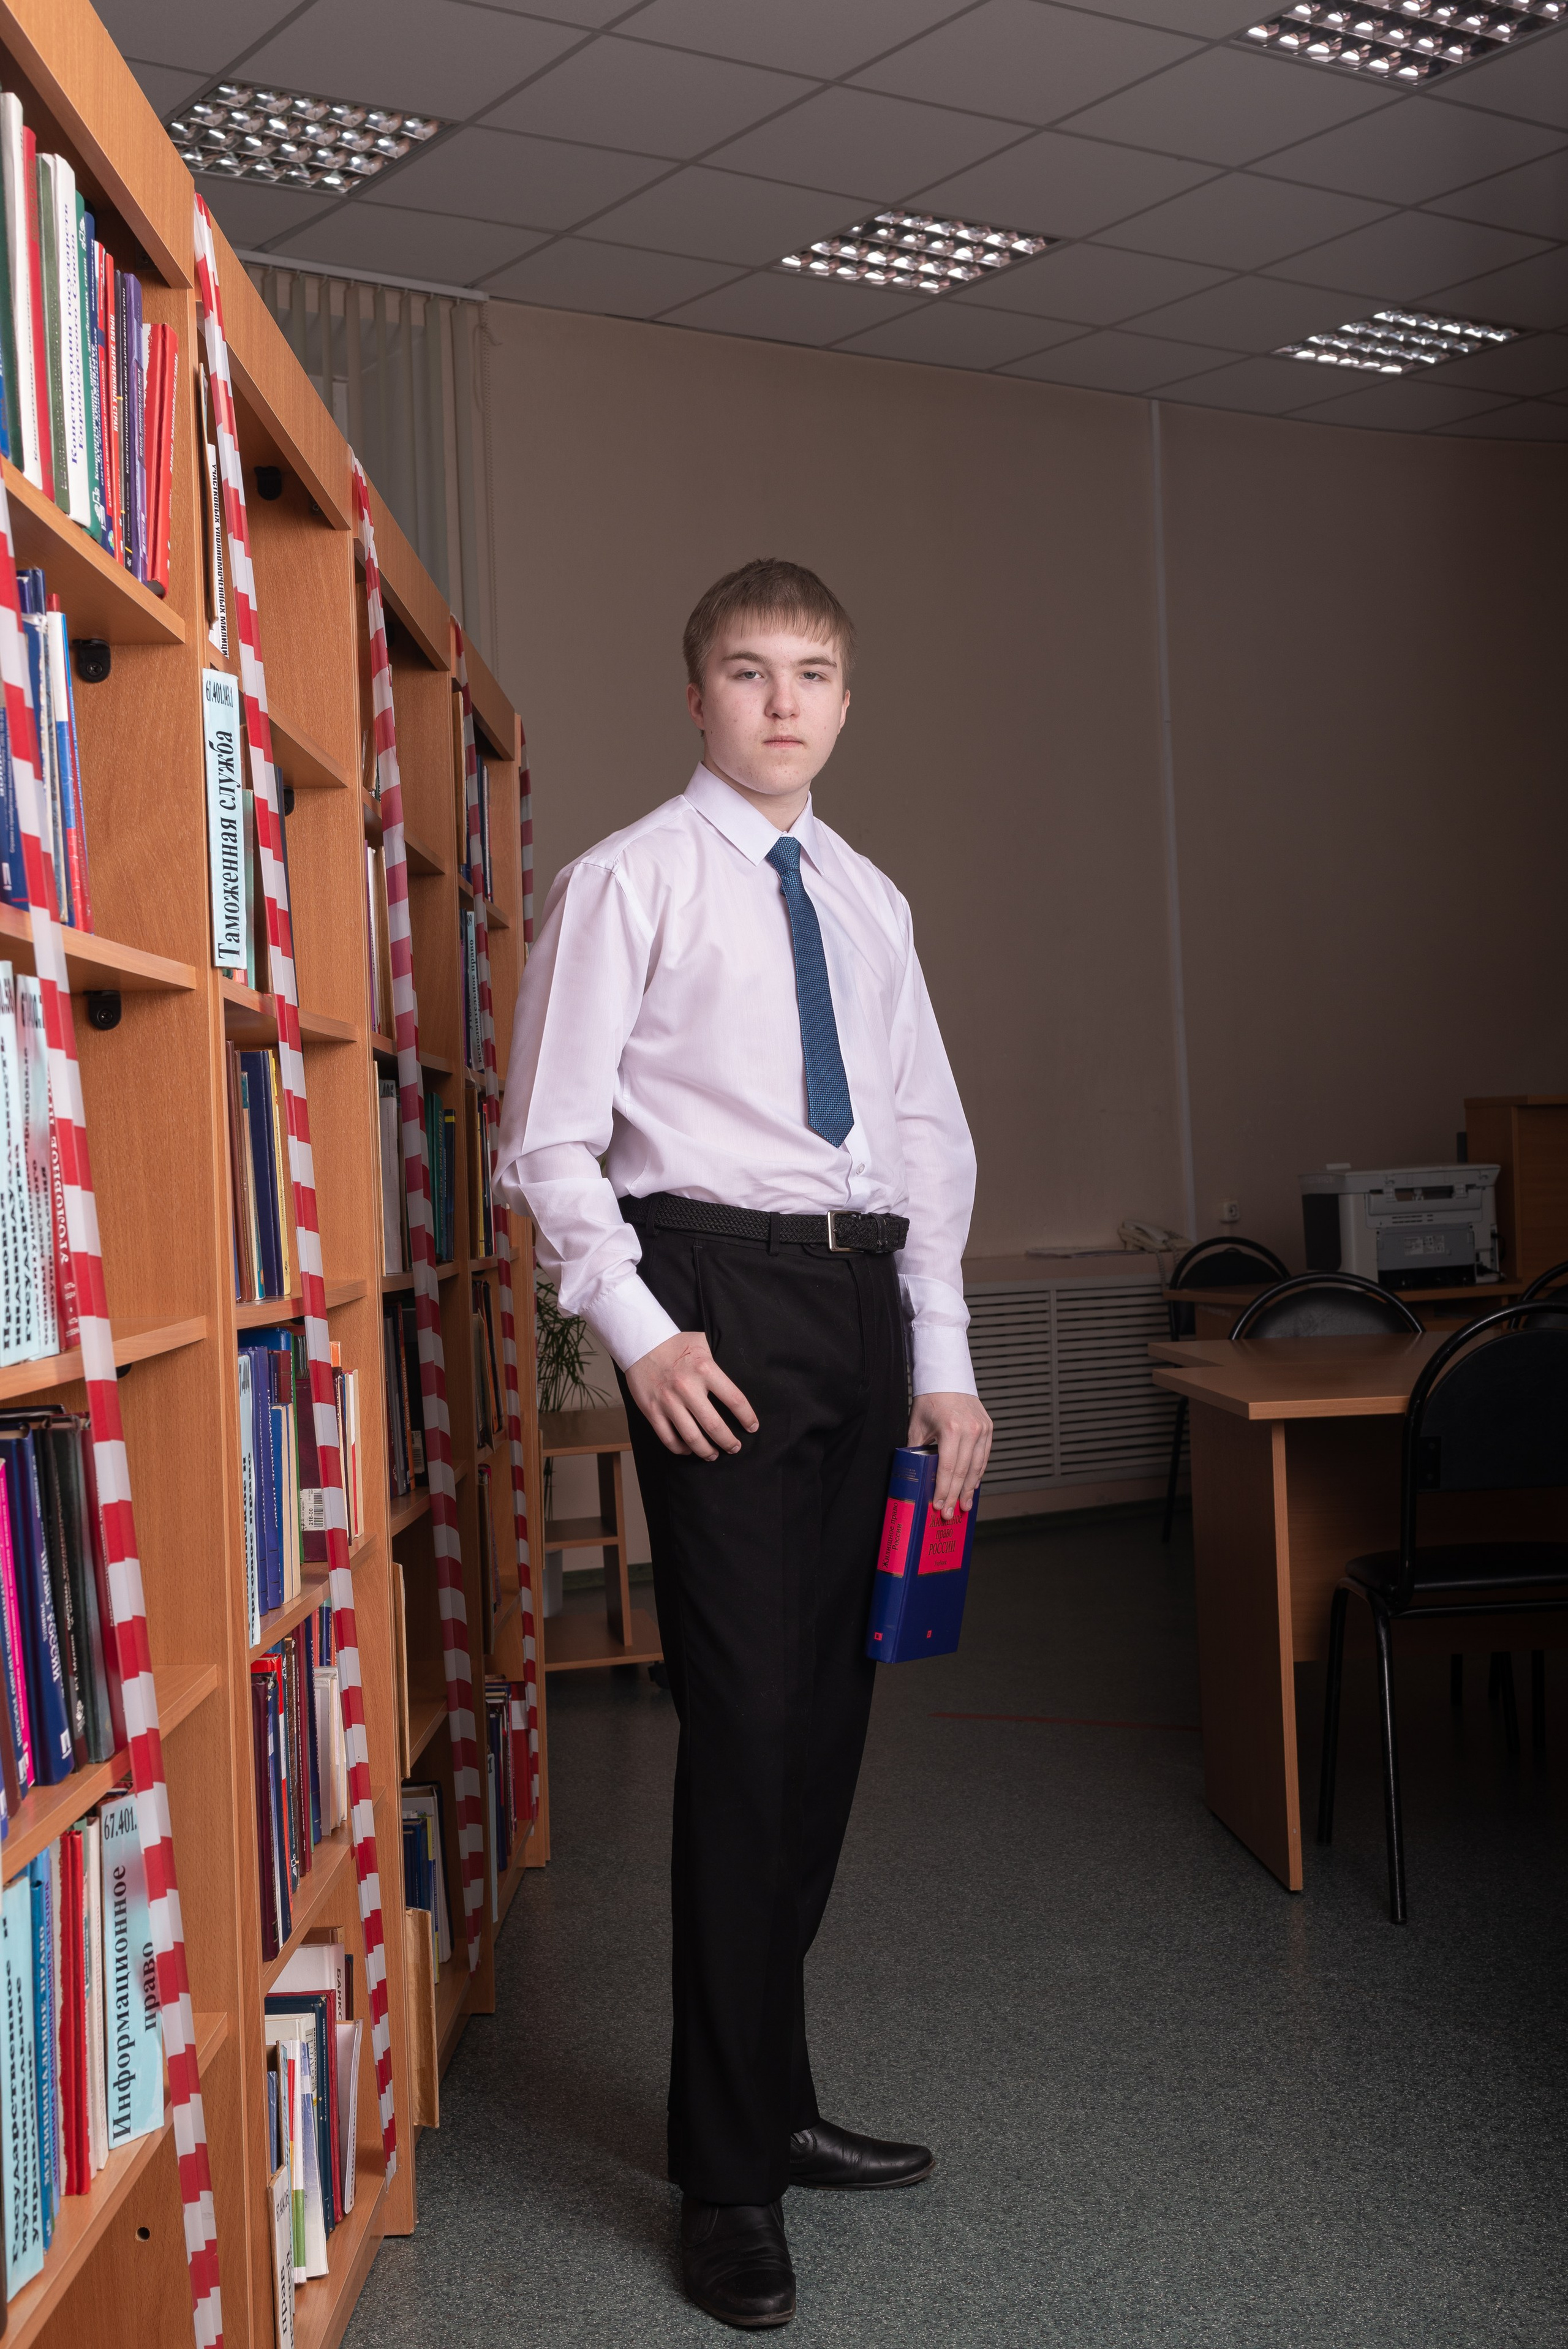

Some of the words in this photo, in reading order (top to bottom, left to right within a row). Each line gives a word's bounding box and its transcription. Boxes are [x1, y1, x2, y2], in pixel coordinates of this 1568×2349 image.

[68, 326, 77, 464] Конституции
[74, 309, 83, 450] Европейского
[215, 527, 225, 613] УПОЛНОМОЧЕННЫХ
[208, 730, 240, 810] служба
[217, 816, 240, 958] Таможенная
[14, 1145, 31, 1342] государства
[50, 1136, 69, 1264] УГОЛОВНОЕ
[882, 1526, 895, 1569] Жилищное
[892, 1523, 903, 1551] России
[928, 1540, 956, 1556] РОССИИ
[936, 1529, 954, 1542] право
[46, 1613, 61, 1682] РОССИИ
[113, 1865, 135, 2140] Информационное
[142, 1941, 159, 2031] право
[16, 1977, 29, 2253] муниципальное
[28, 2041, 39, 2244] управление
[40, 2000, 49, 2185] МУНИЦИПАЛЬНОЕ
[279, 2265, 288, 2336] прав
